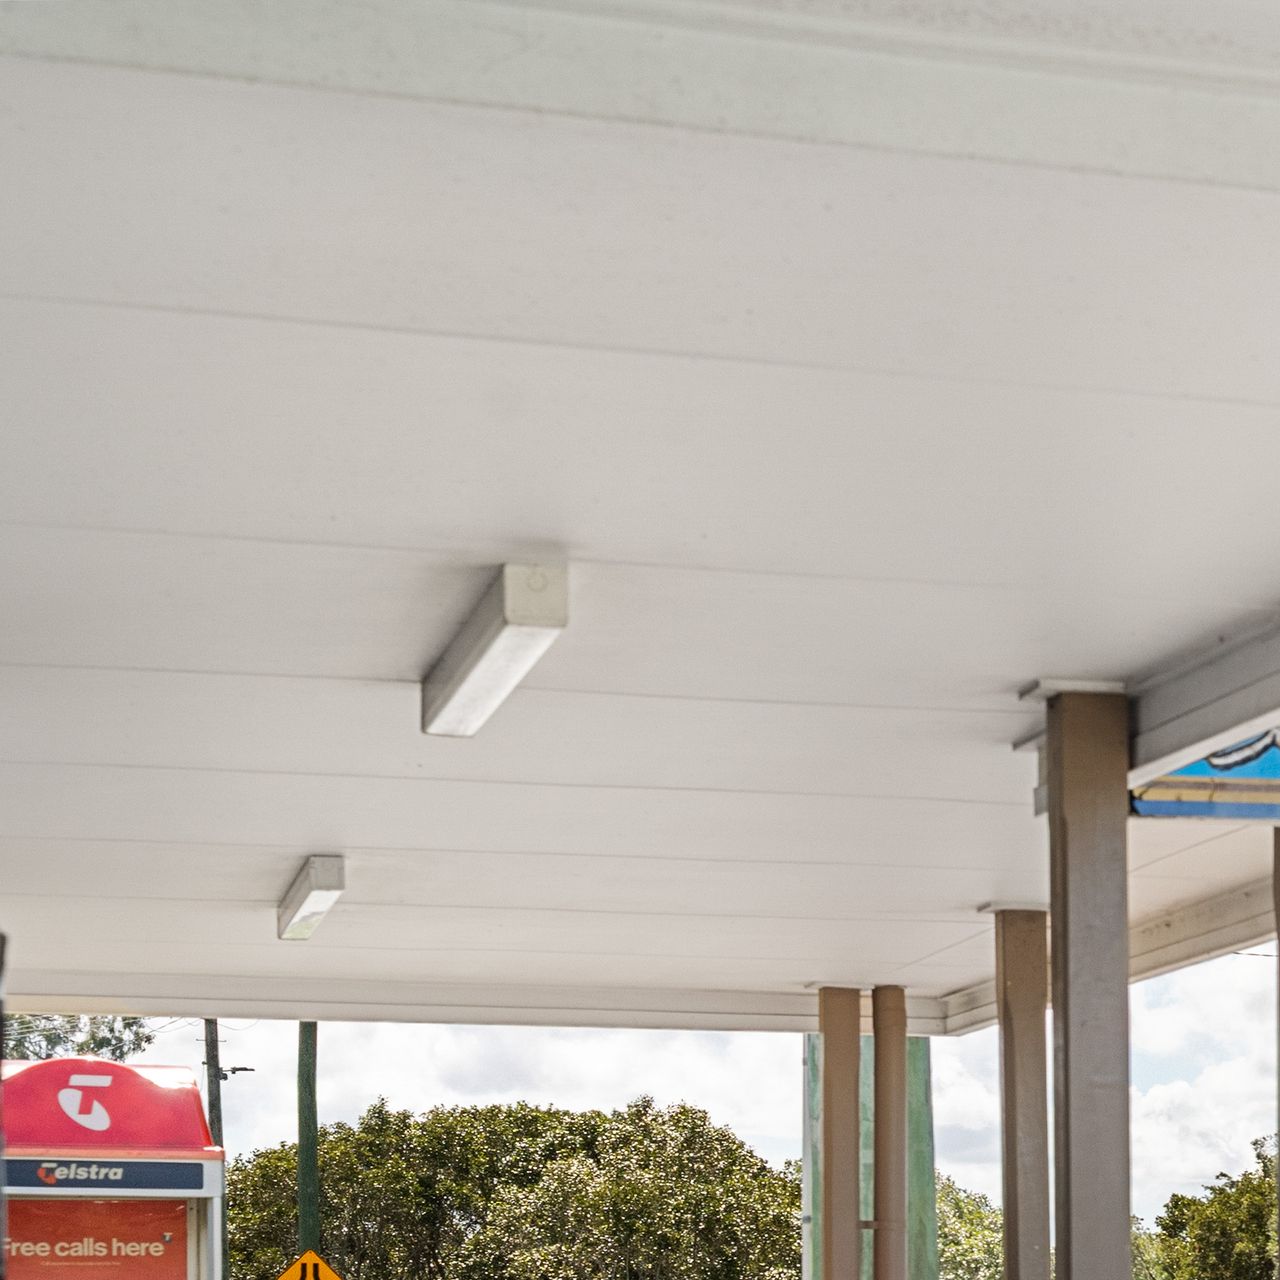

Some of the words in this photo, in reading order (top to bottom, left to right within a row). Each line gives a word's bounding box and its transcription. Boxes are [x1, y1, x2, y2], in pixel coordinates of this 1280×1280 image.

[37, 1163, 124, 1185] Telstra
[54, 1237, 107, 1257] calls
[111, 1237, 164, 1257] here
